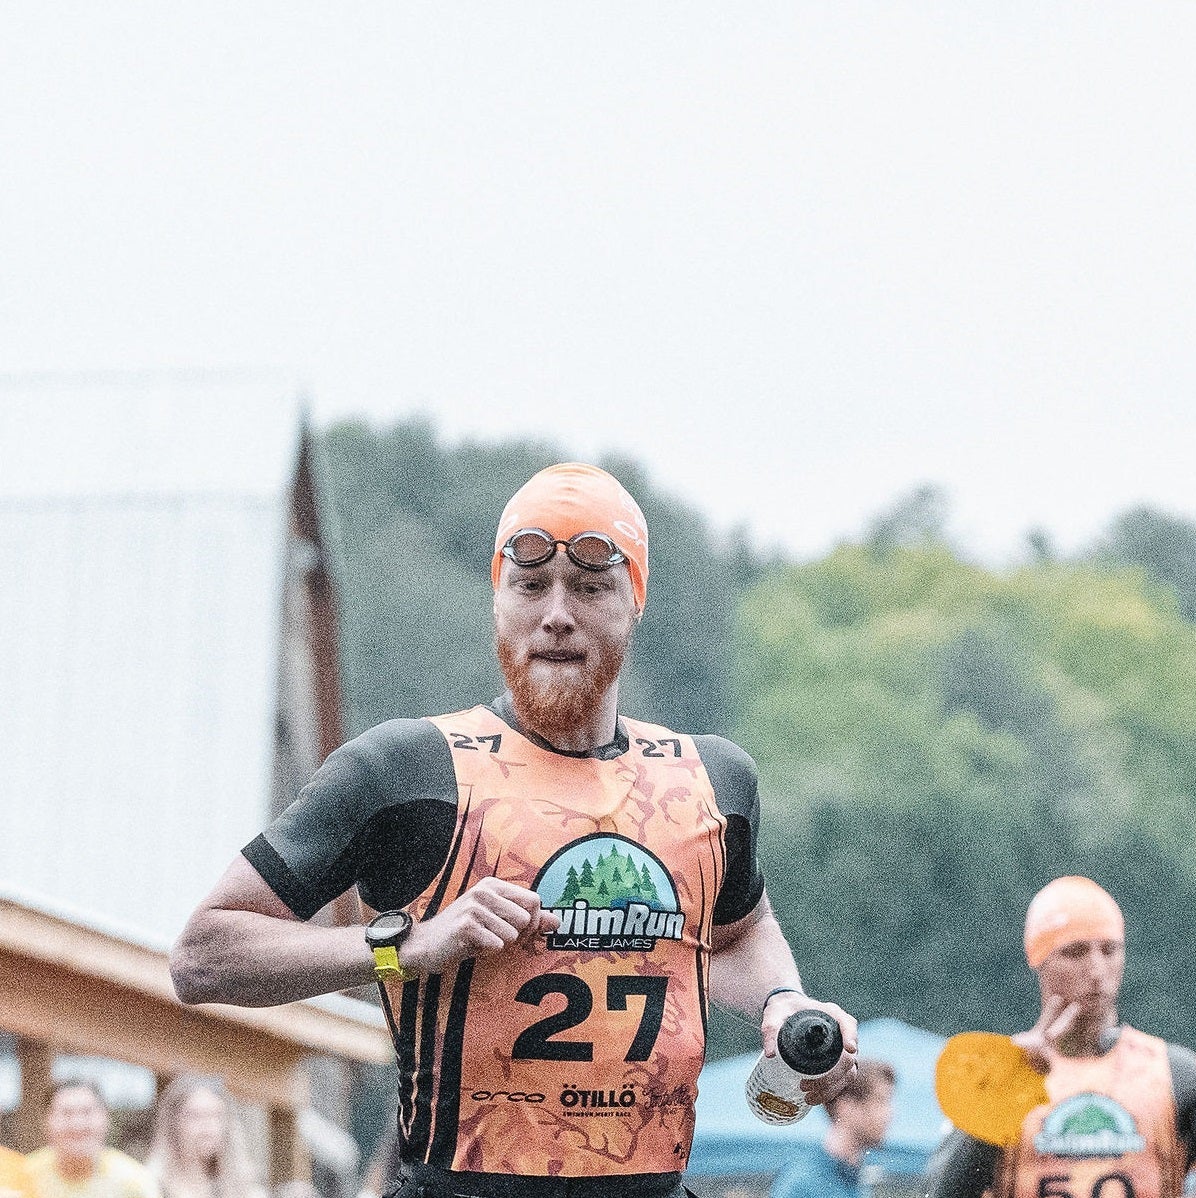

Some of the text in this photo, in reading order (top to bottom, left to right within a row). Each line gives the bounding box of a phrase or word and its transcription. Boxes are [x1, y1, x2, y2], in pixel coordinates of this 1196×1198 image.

[450, 732, 502, 754] 27
[635, 738, 682, 758] 27
[540, 900, 685, 940] wimRun
[552, 937, 652, 949] LAKE JAMES
[511, 972, 670, 1062] 27
[560, 1083, 636, 1108] ÖTILLÖ
